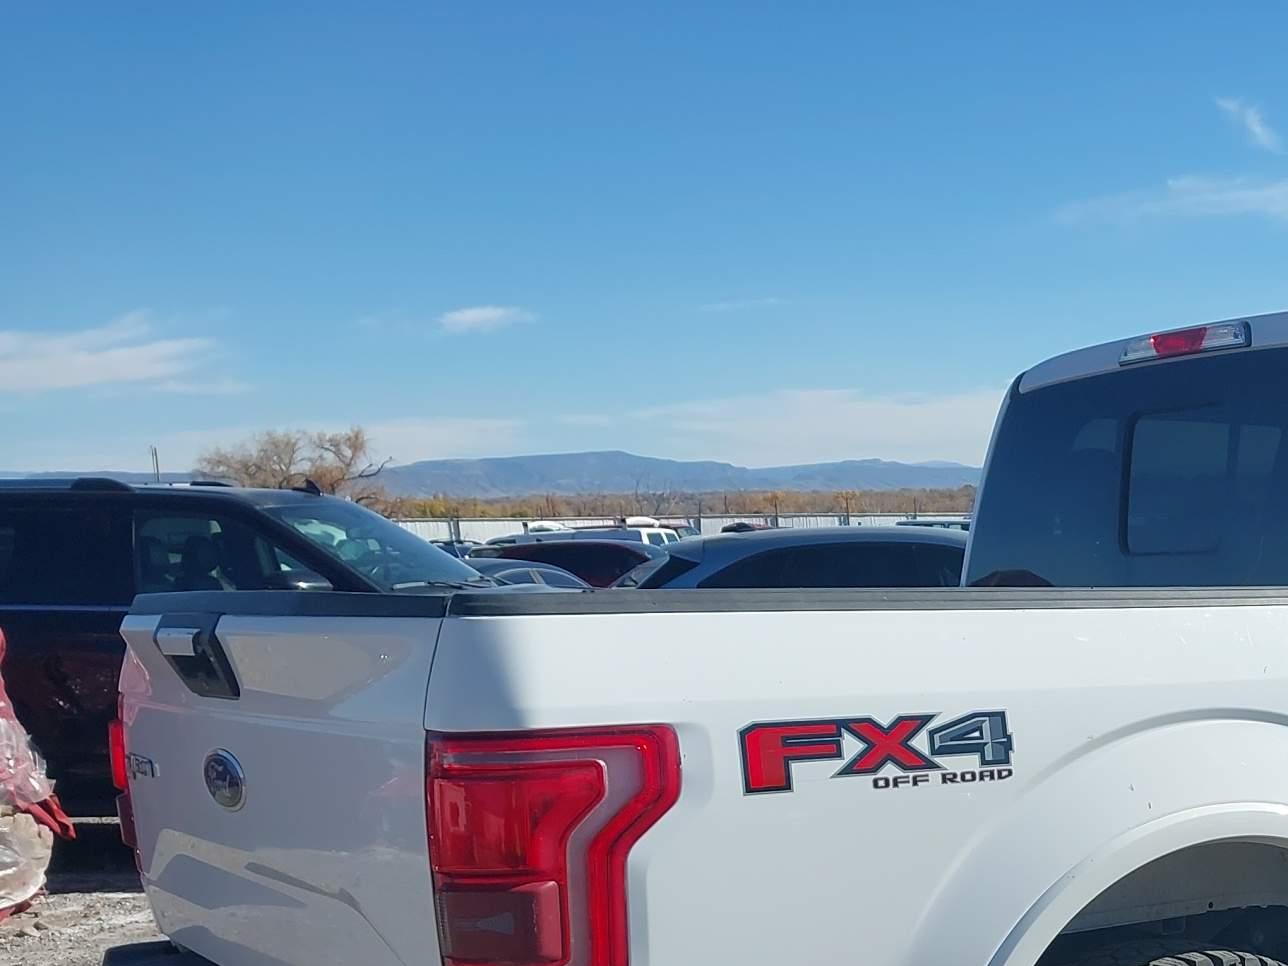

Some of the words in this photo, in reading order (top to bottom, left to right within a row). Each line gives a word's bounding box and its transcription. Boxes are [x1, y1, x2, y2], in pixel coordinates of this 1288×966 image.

[737, 708, 1015, 797] FX4
[872, 774, 930, 789] OFF
[941, 767, 1014, 785] ROAD
